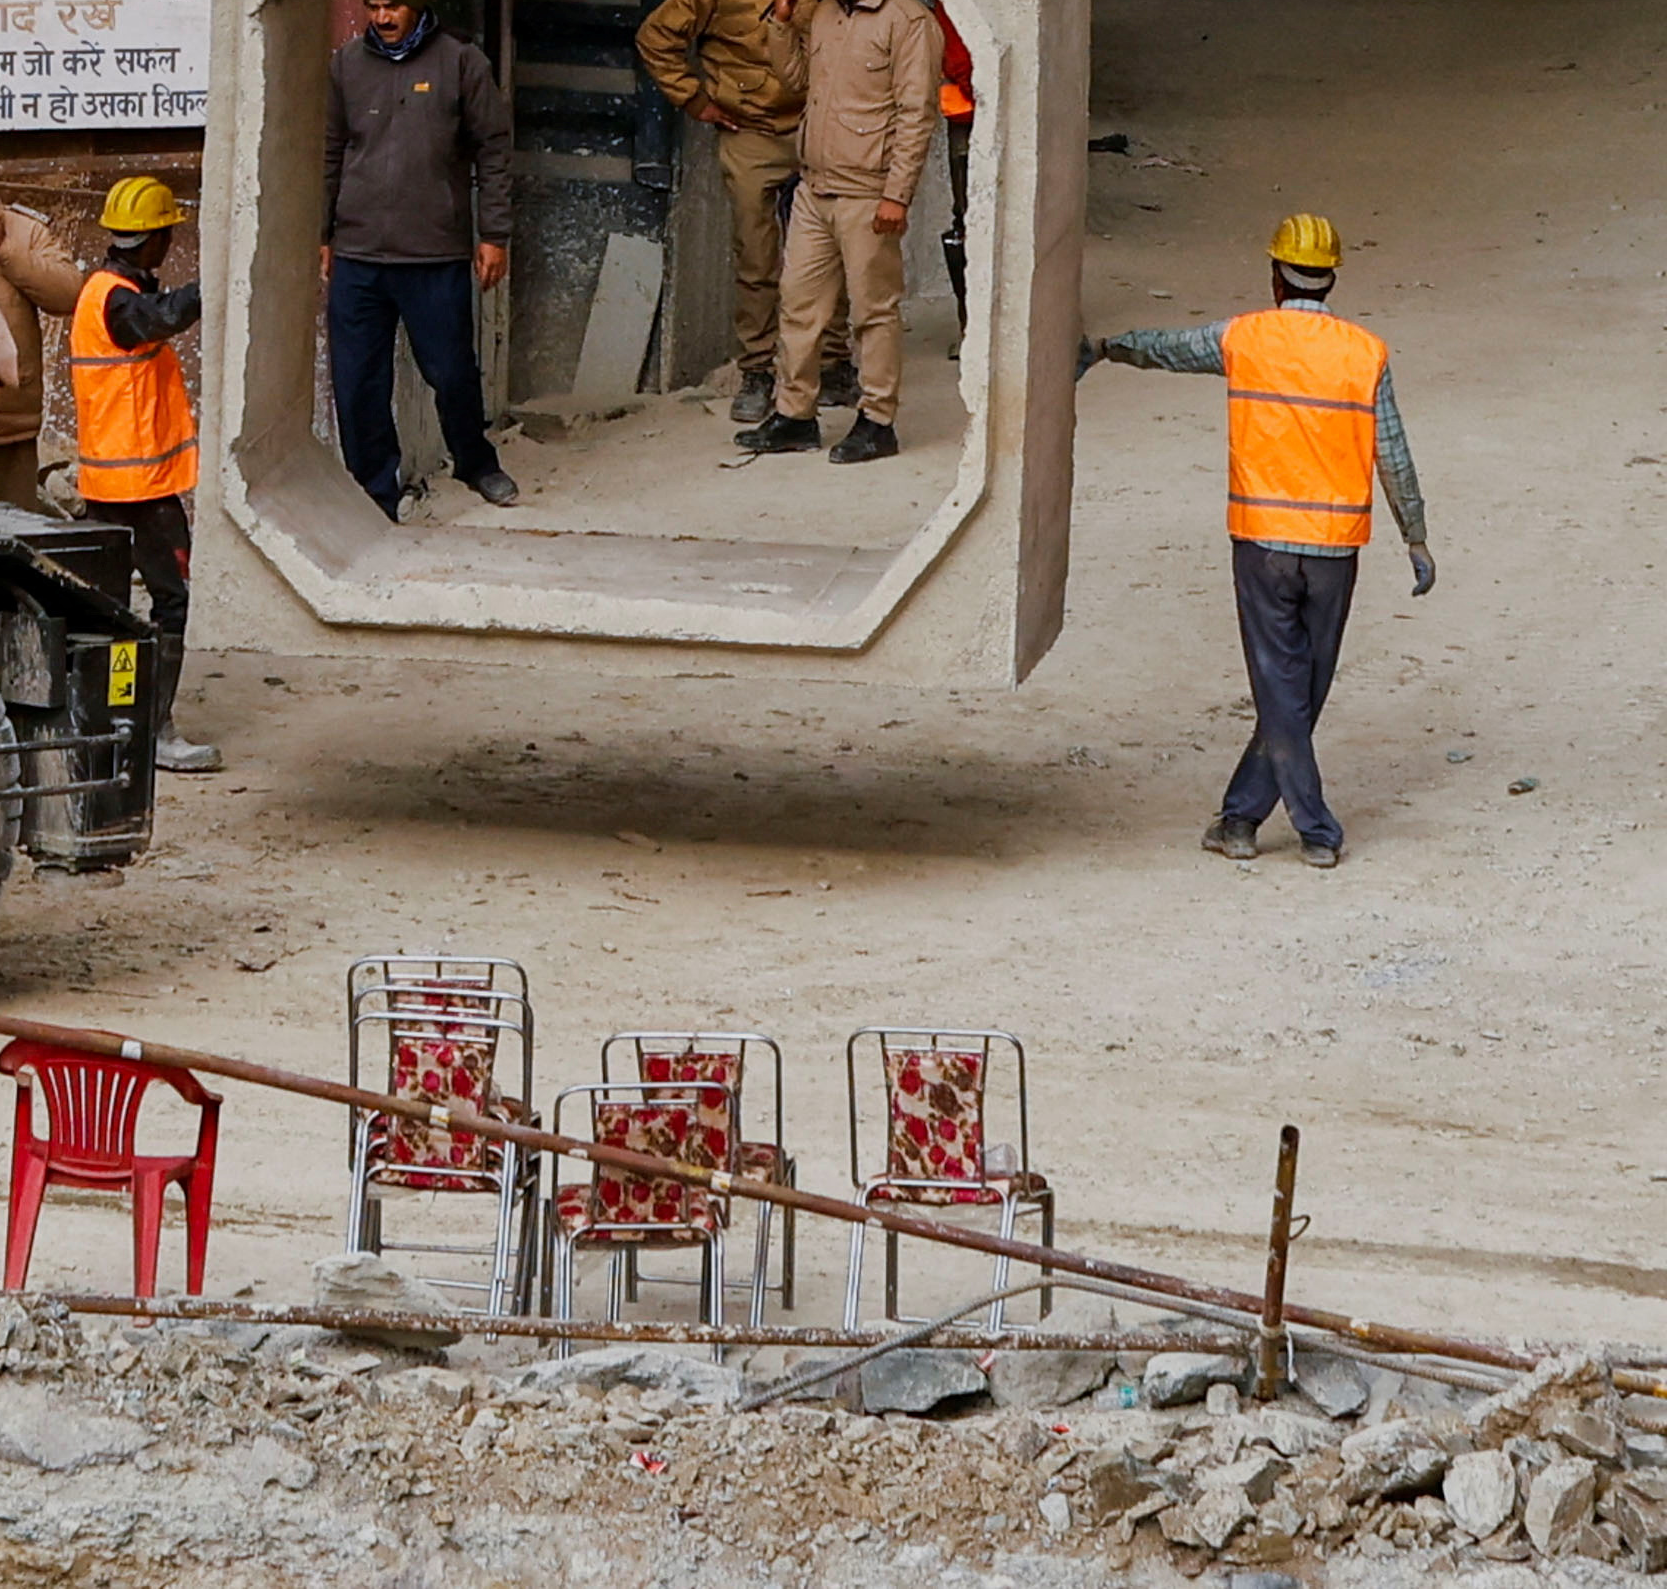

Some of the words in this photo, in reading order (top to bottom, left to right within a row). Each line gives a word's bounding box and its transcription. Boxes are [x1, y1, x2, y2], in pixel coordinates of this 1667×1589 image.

[22, 41, 55, 77] जो
[62, 40, 105, 77] करें
[20, 92, 42, 119] न
[47, 85, 79, 124] हो
[81, 92, 148, 119] उसका
